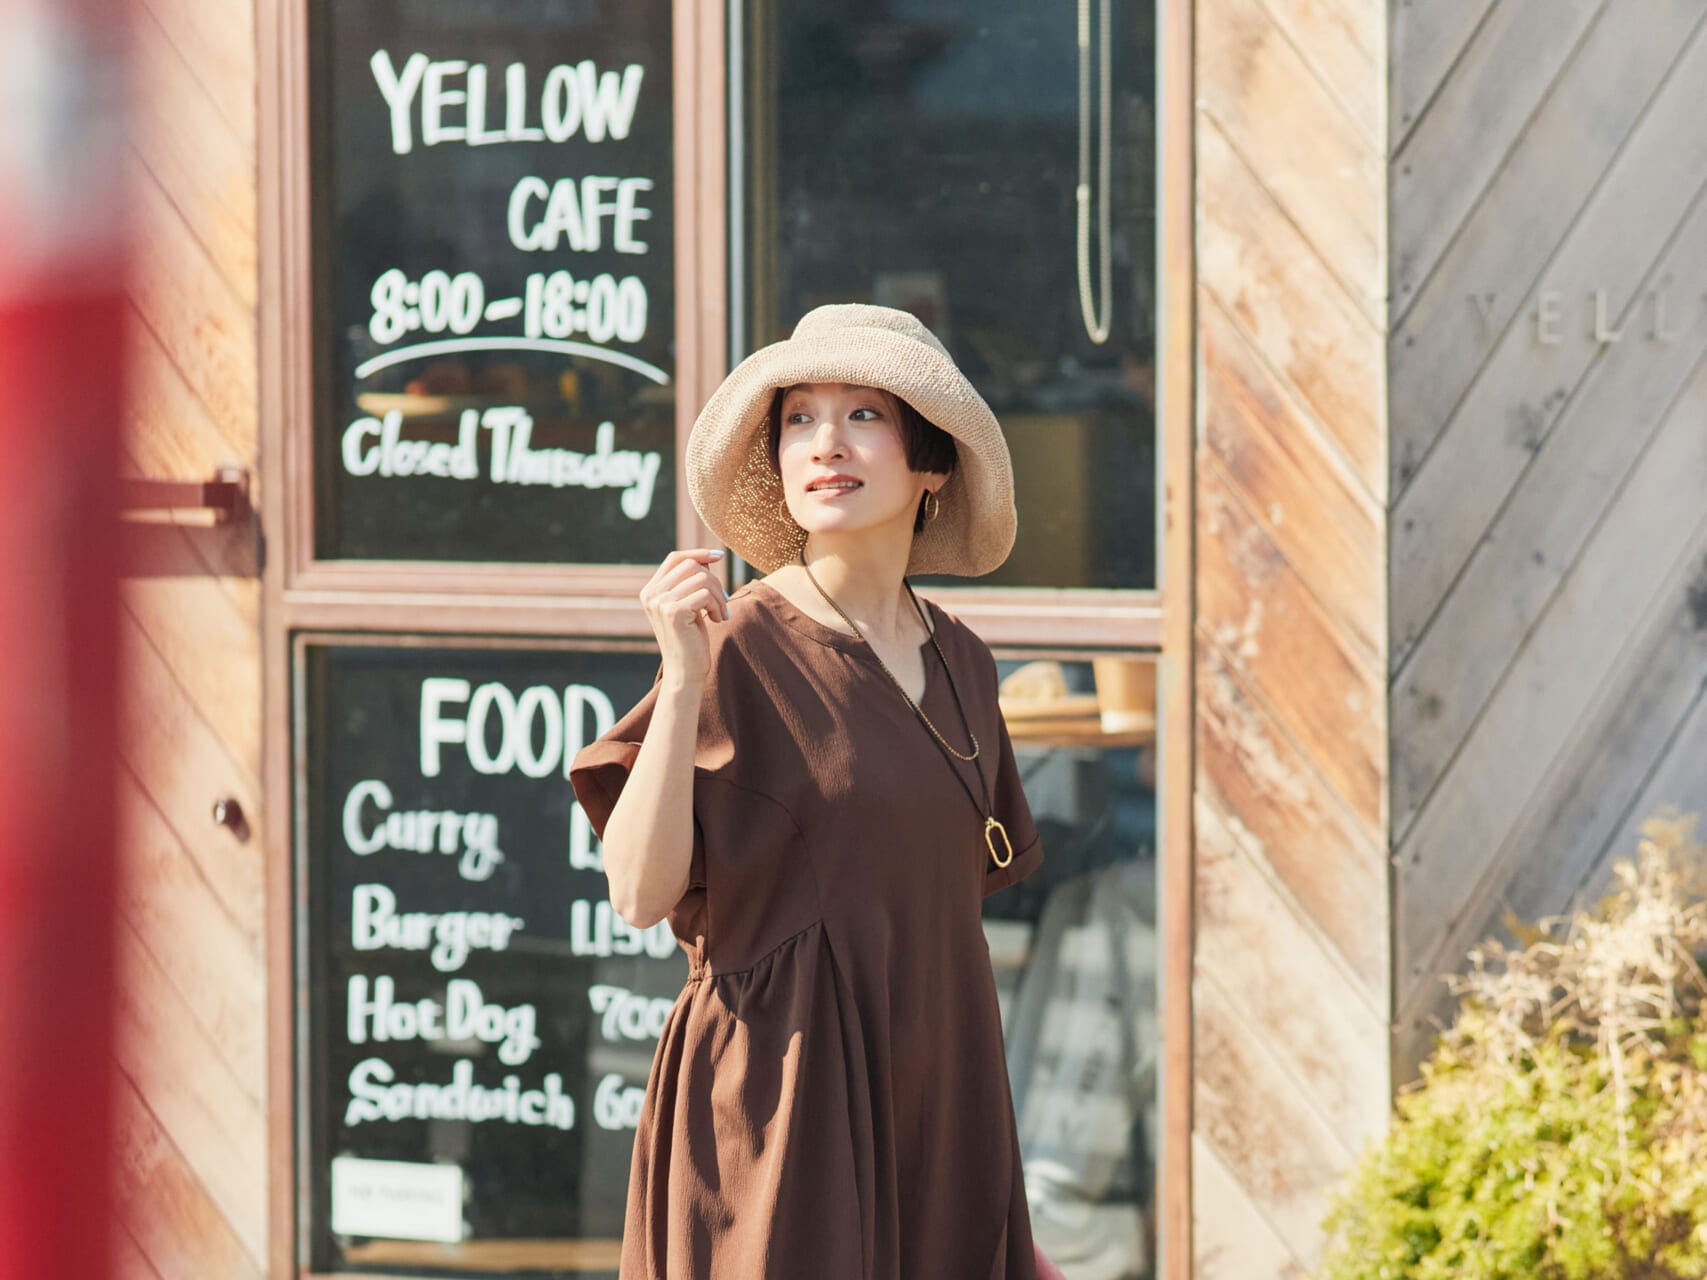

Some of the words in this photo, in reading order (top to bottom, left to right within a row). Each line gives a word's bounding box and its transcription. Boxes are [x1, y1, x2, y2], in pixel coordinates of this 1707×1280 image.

[370, 49, 644, 154] YELLOW
[507, 175, 653, 254] CAFE
[341, 409, 479, 480] Closed
[481, 406, 662, 520] Thursday
[419, 677, 616, 782] FOOD
[342, 779, 505, 882] Curry
[352, 883, 525, 972] Burger
[347, 974, 444, 1044] Hot
[446, 978, 542, 1066] Dog
[344, 1057, 575, 1130] Sandwich
